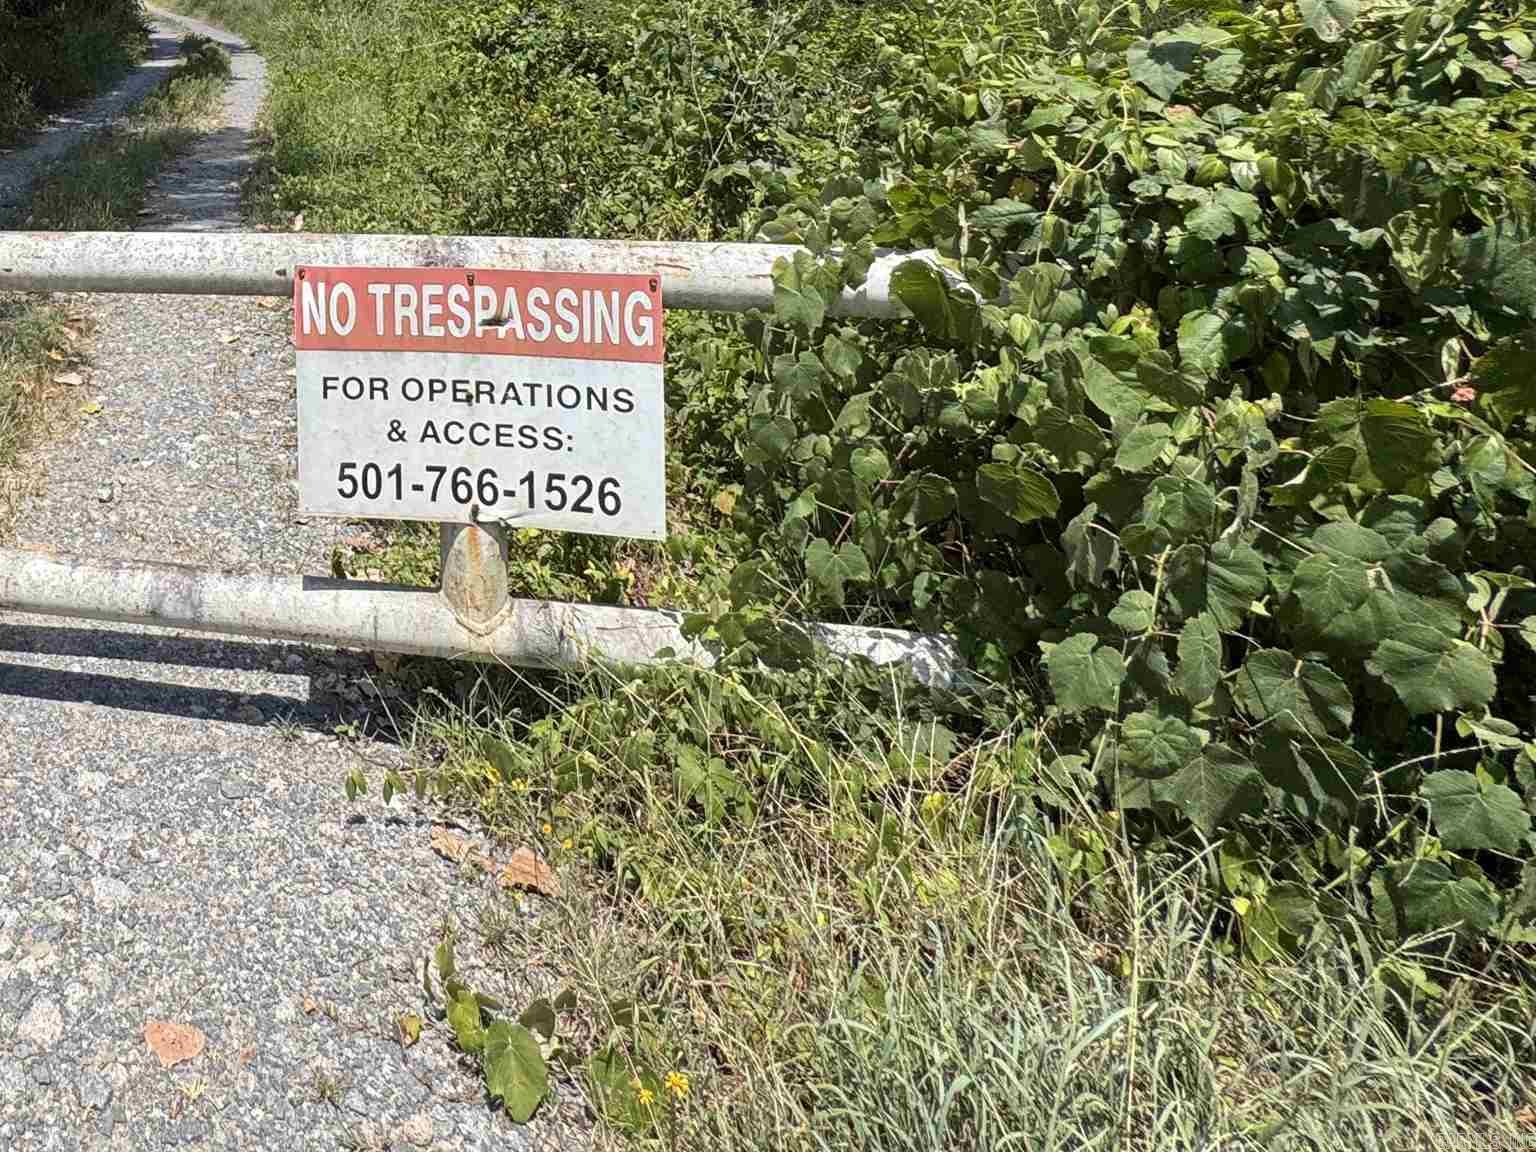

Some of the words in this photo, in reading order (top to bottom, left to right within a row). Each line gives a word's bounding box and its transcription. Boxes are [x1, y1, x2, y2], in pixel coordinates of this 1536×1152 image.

[301, 281, 357, 336] NO
[367, 283, 655, 346] TRESPASSING
[322, 376, 389, 401] FOR
[401, 377, 635, 413] OPERATIONS
[386, 419, 407, 443] &
[419, 420, 574, 452] ACCESS:
[337, 462, 622, 516] 501-766-1526
